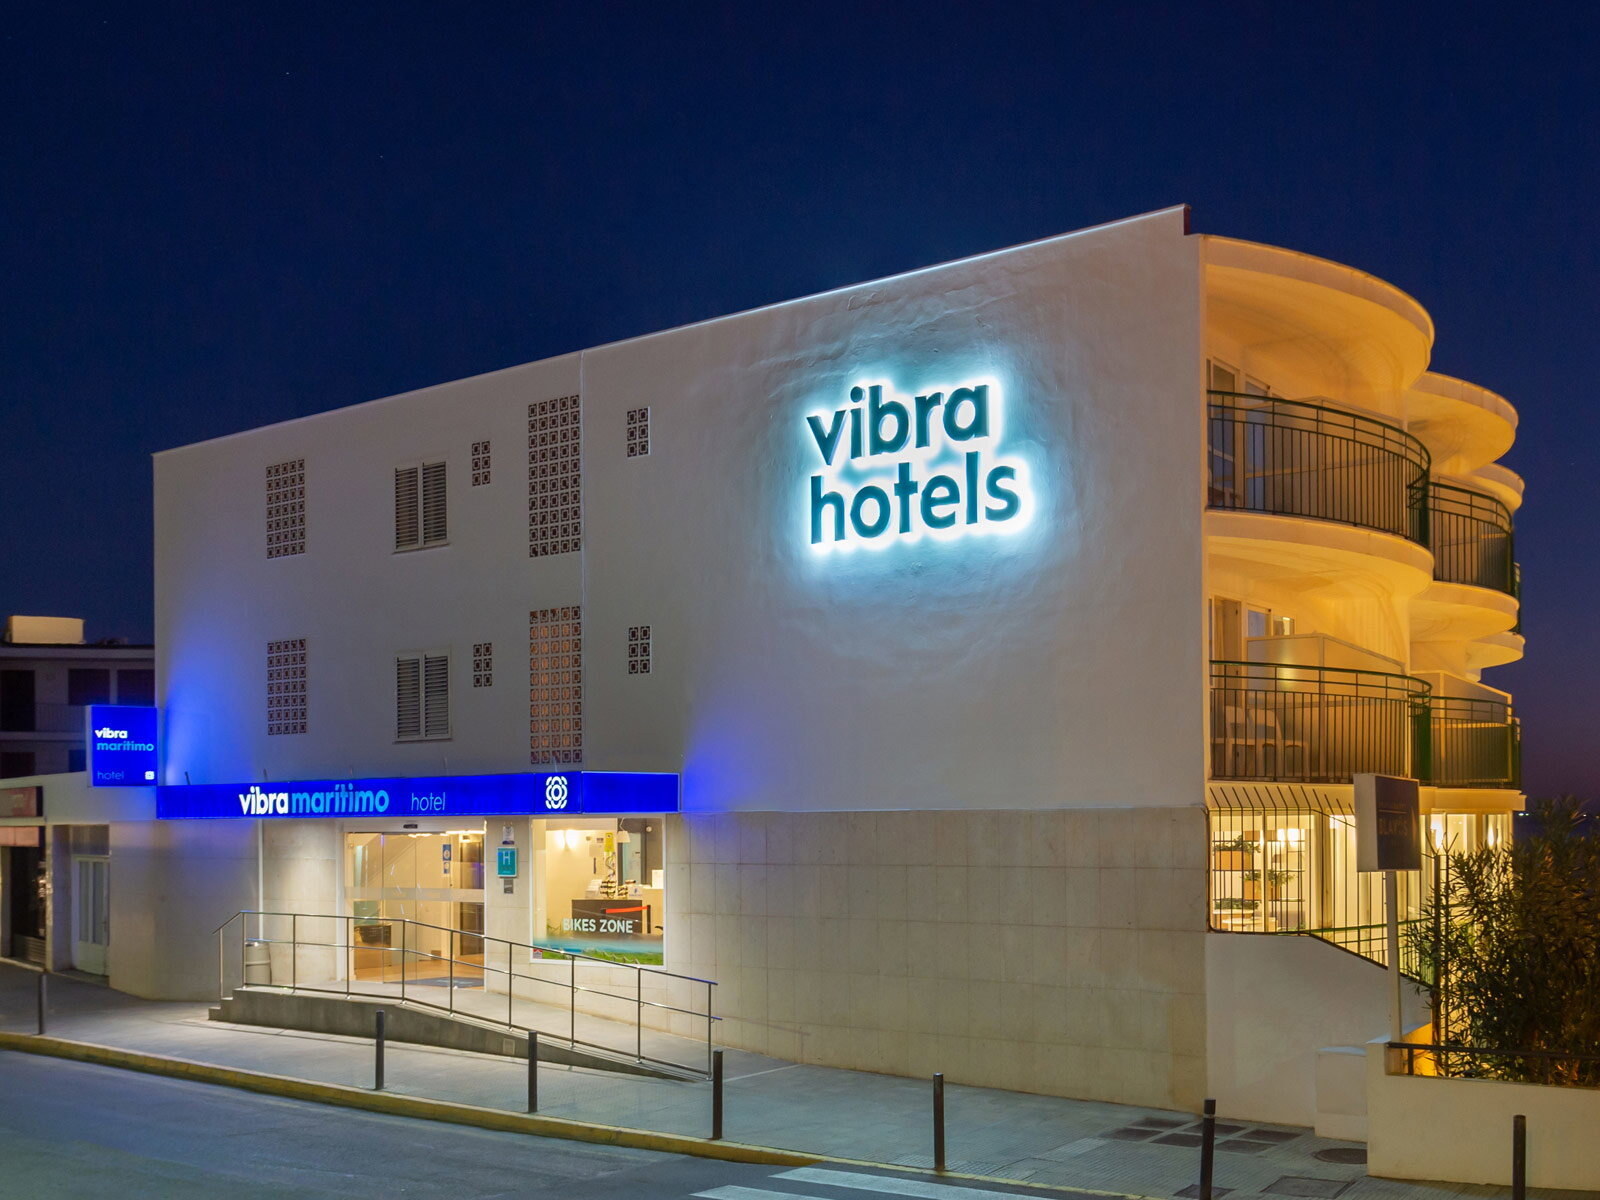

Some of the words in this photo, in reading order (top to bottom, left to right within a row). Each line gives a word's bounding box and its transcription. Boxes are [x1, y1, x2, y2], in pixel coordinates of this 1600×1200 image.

[806, 384, 990, 466] vibra
[810, 450, 1022, 545] hotels
[94, 727, 128, 739] vibra
[97, 770, 125, 780] hotel
[411, 792, 447, 812] hotel
[502, 850, 511, 866] H
[562, 918, 597, 932] BIKES
[599, 919, 634, 934] ZONE
